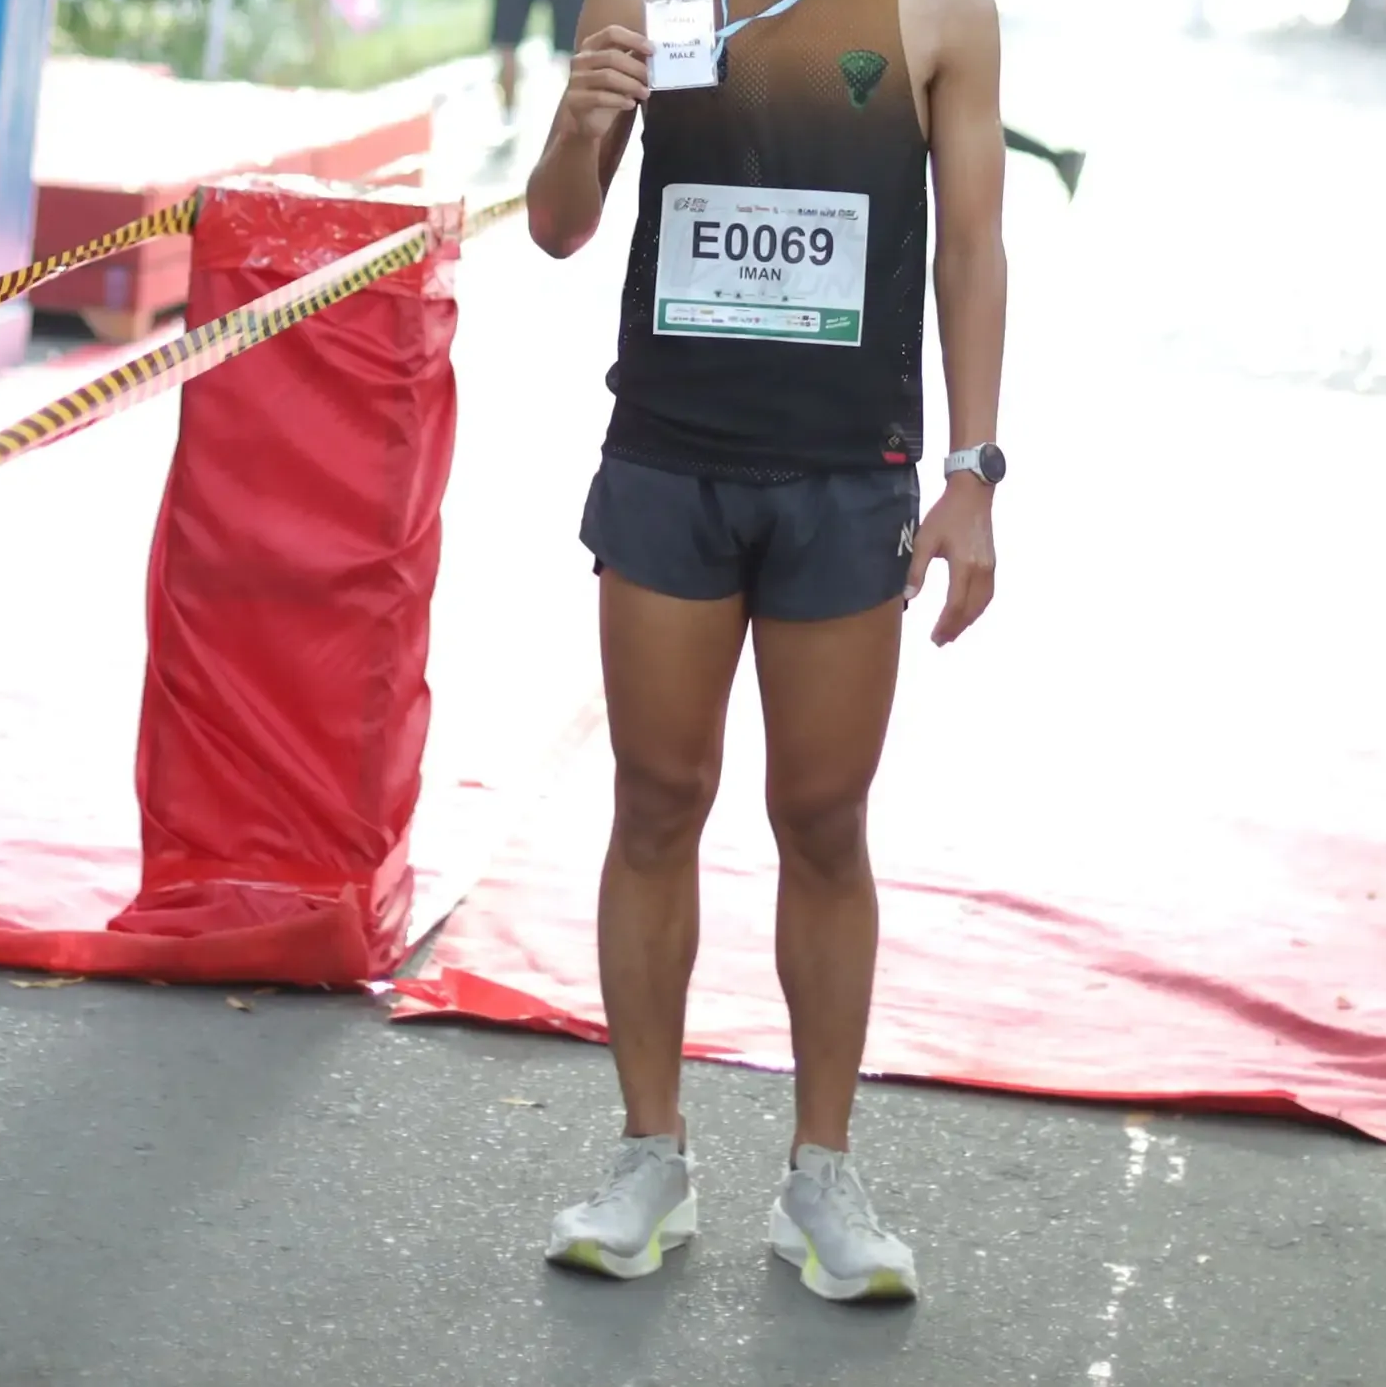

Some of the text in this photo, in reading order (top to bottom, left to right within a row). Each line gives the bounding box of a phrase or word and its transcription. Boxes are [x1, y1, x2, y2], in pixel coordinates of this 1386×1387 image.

[670, 52, 695, 60] MALE
[692, 221, 834, 266] E0069
[739, 266, 782, 281] IMAN
